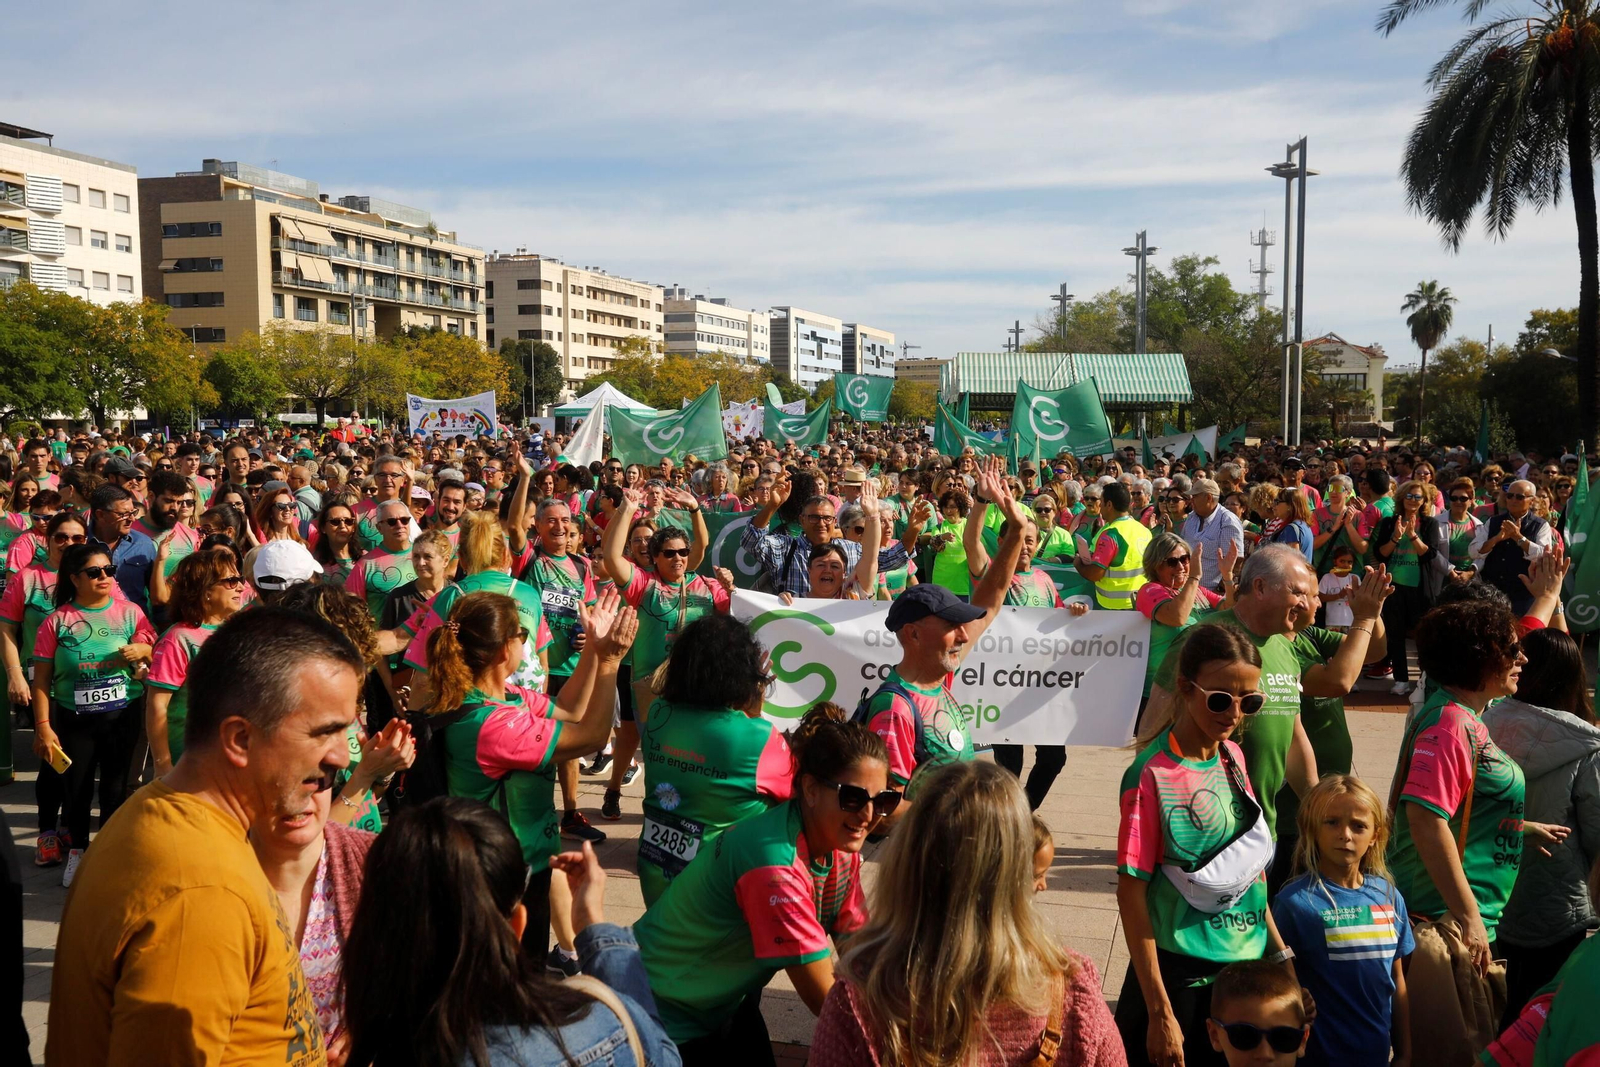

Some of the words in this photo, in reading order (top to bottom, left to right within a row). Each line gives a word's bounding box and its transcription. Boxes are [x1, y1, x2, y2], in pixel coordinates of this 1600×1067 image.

[547, 592, 575, 608] 2655
[78, 650, 96, 660] La
[1022, 633, 1143, 661] española
[961, 662, 985, 686] el
[992, 663, 1085, 689] cáncer
[1266, 672, 1297, 687] aecc
[82, 687, 118, 703] 1651
[650, 740, 660, 752] La
[662, 744, 706, 764] marcha
[648, 752, 666, 764] que
[667, 757, 729, 780] engancha
[650, 824, 687, 855] 2485
